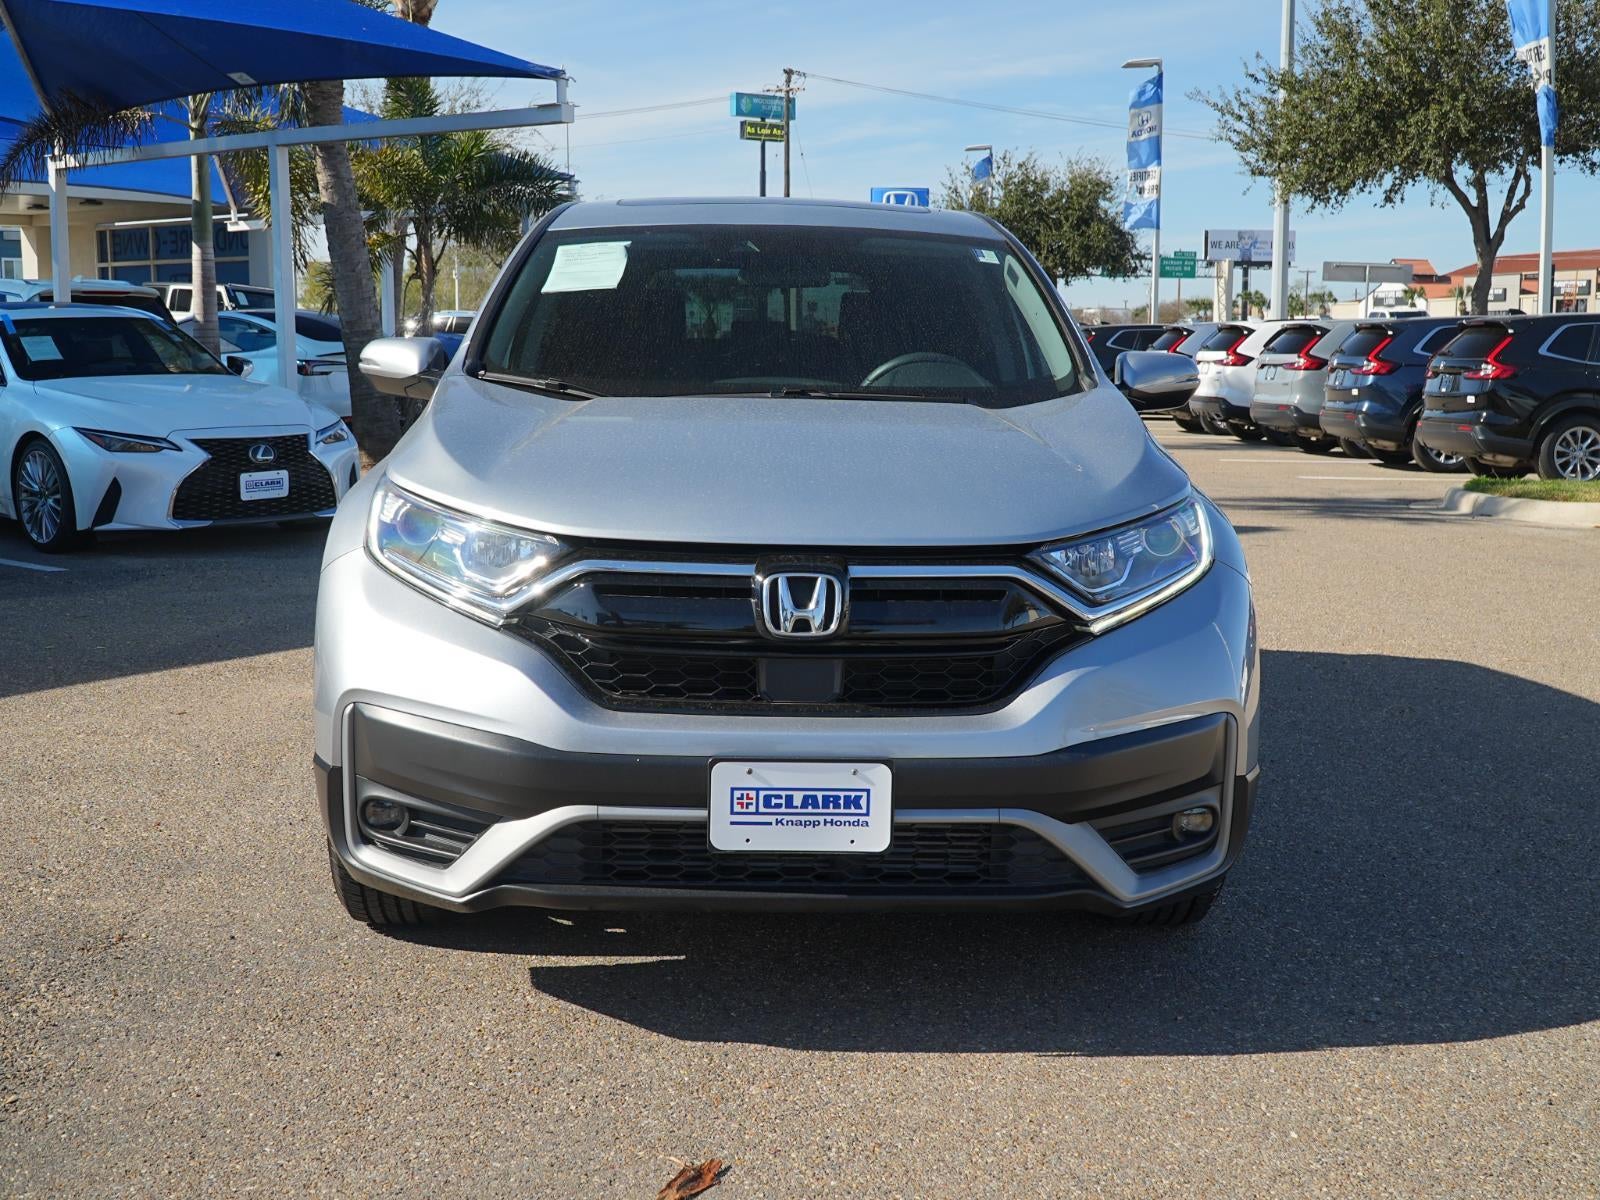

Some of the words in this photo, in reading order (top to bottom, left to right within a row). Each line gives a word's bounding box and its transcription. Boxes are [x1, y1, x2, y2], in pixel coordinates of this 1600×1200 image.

[757, 127, 771, 135] Low
[1210, 240, 1223, 249] WE
[1224, 240, 1241, 249] ARE
[762, 793, 864, 810] CLARK
[775, 817, 821, 829] Knapp
[823, 818, 870, 828] Honda
